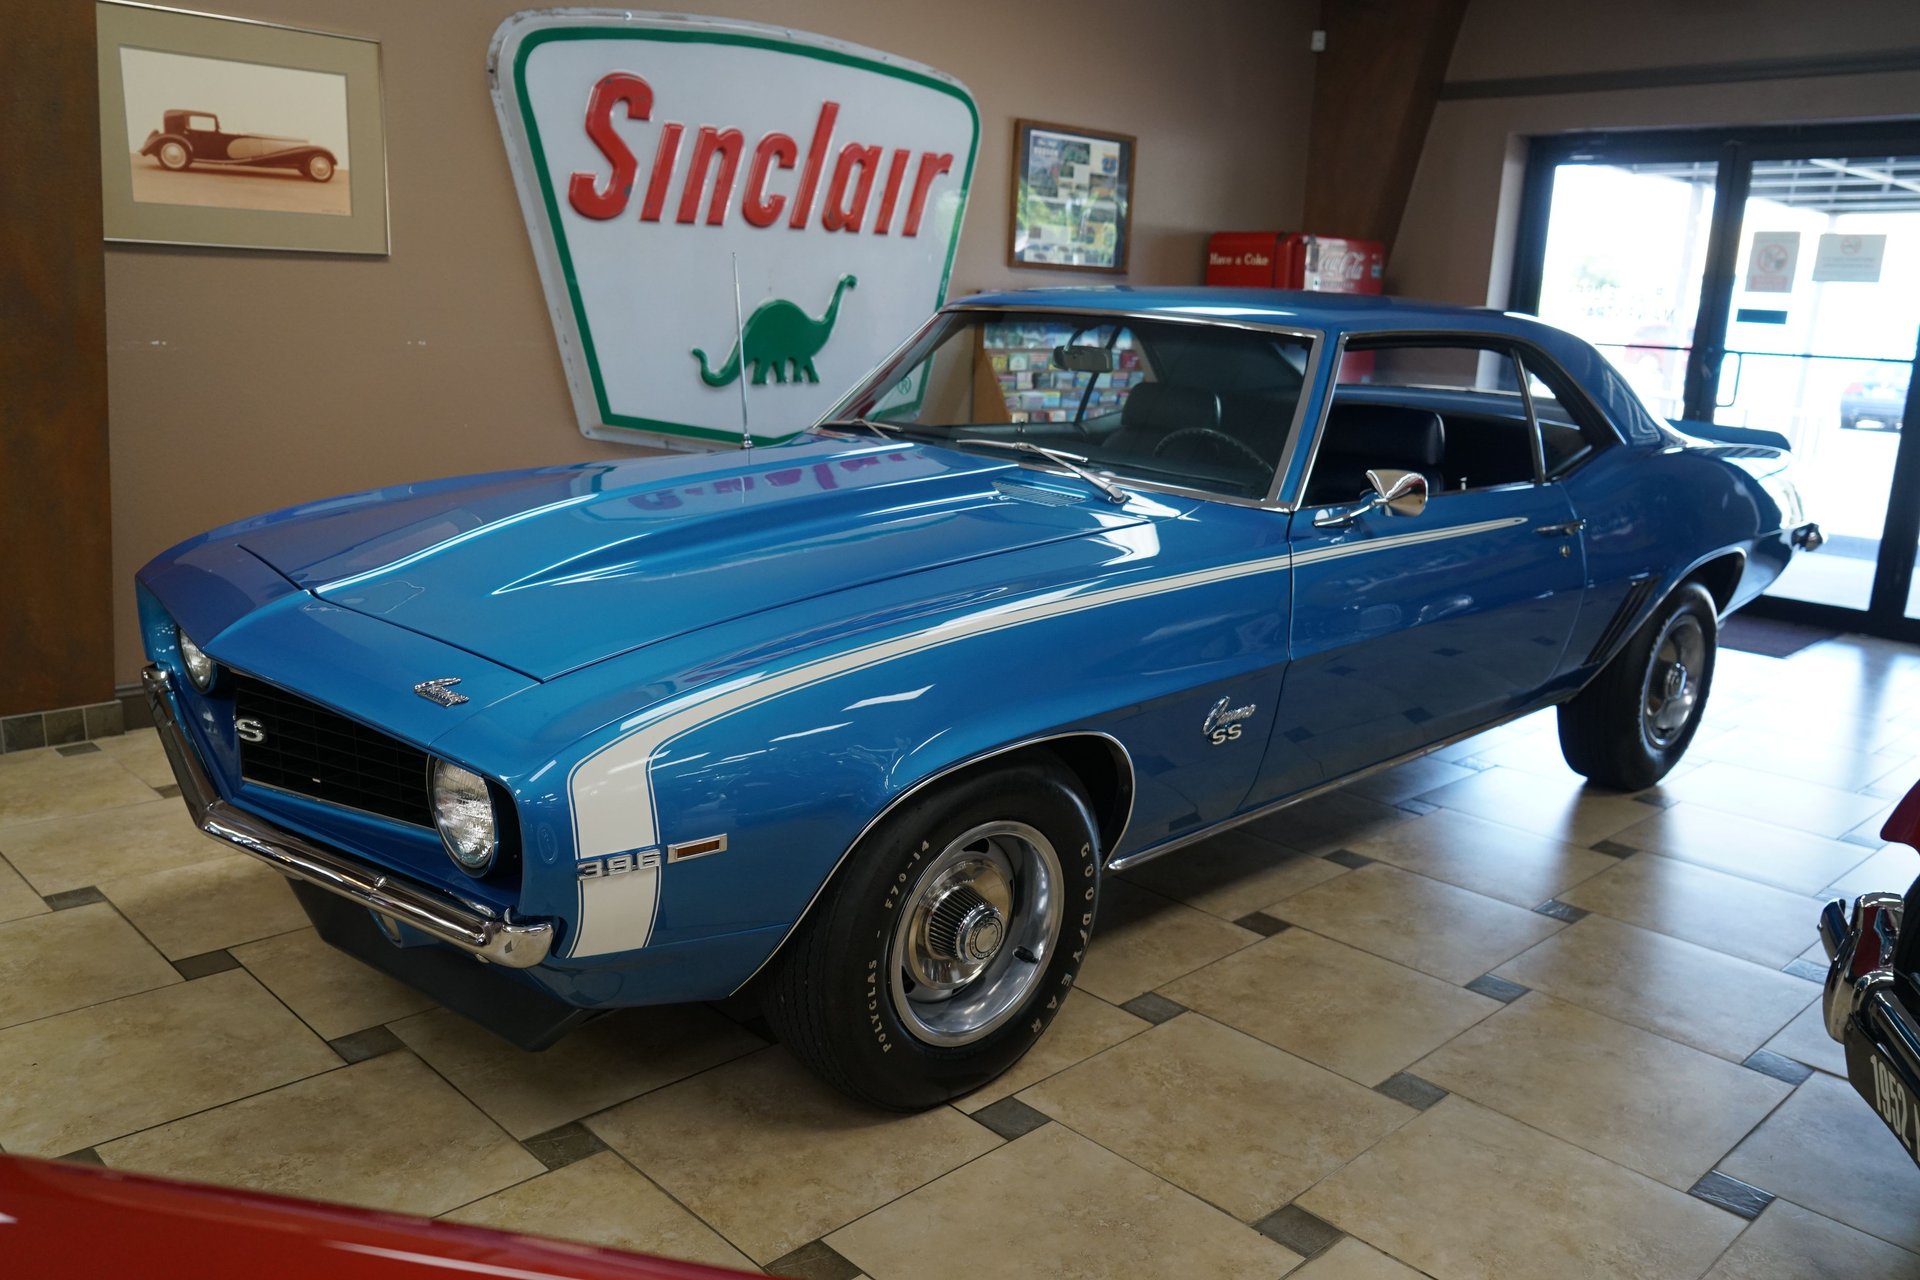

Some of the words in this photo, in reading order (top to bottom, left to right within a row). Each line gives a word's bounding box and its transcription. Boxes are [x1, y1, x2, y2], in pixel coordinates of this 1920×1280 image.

[568, 71, 954, 238] Sinclair
[1209, 252, 1233, 266] Have
[1234, 256, 1242, 265] a
[1243, 253, 1269, 266] Coke
[1212, 723, 1242, 745] SS
[576, 848, 661, 881] 396
[867, 959, 893, 1054] POLYGLAS
[884, 839, 930, 909] F70-14
[1869, 1053, 1912, 1151] 1952
